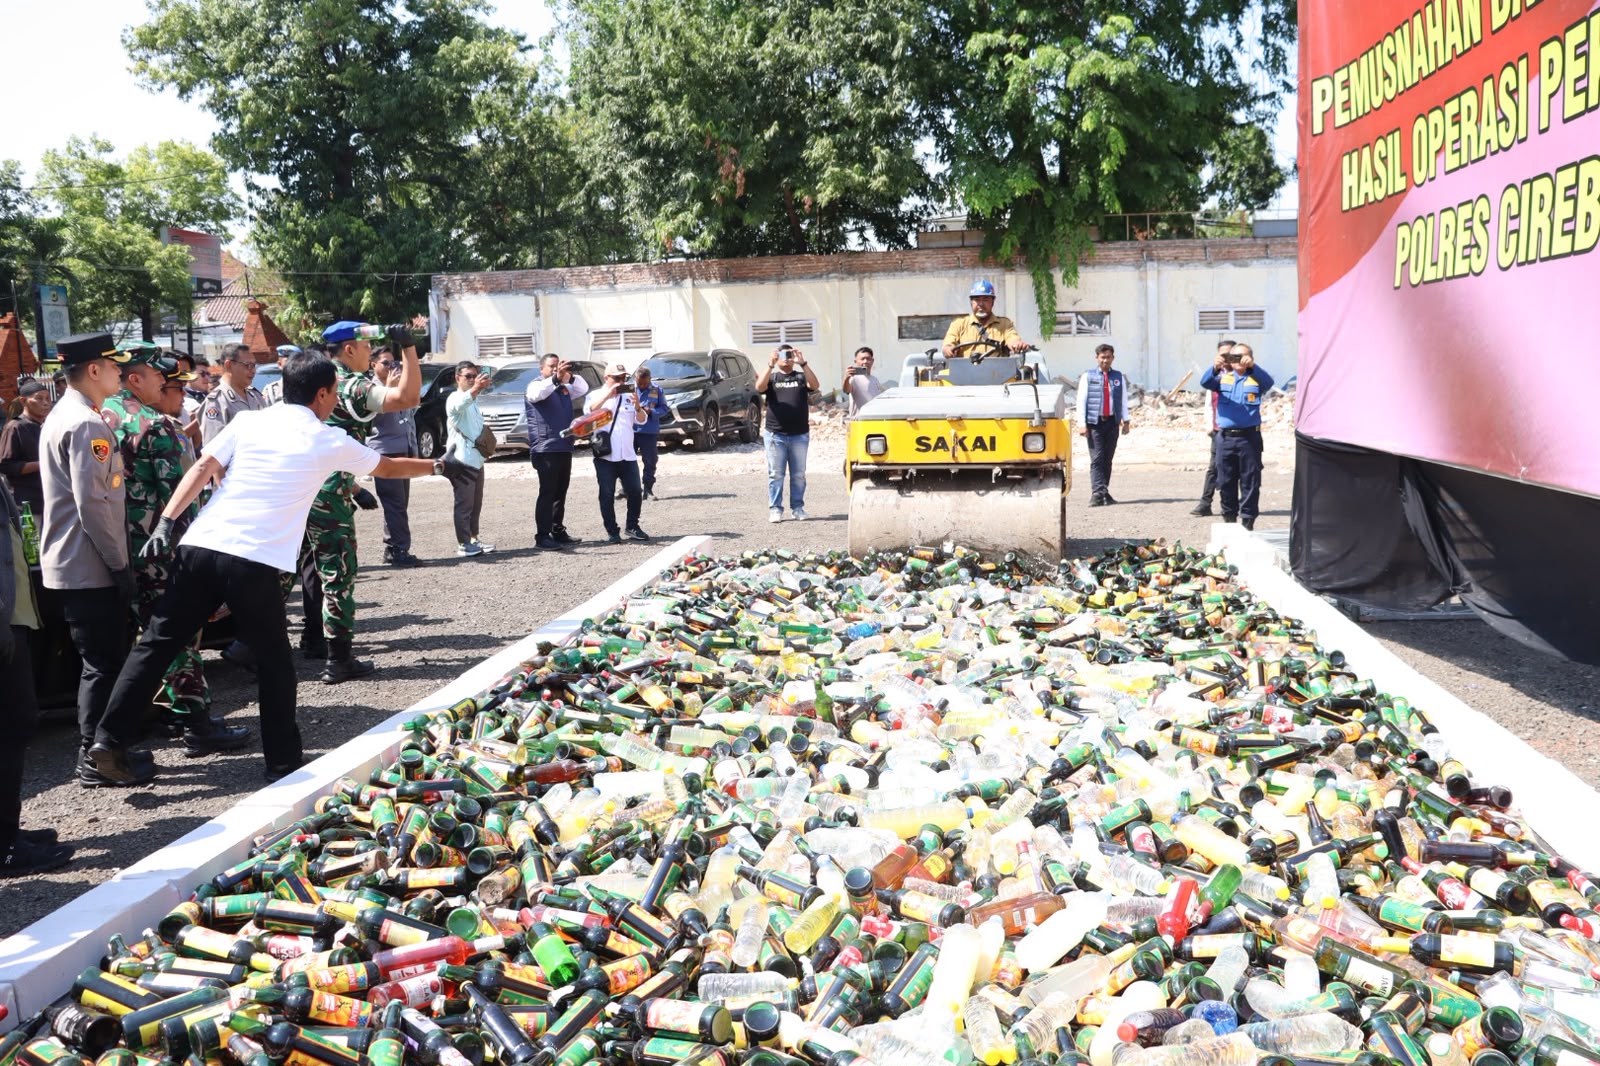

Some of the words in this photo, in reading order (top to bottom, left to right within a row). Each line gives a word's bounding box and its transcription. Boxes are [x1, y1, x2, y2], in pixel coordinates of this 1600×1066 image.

[1312, 0, 1482, 135] PEMUSNAHAN
[1342, 128, 1407, 212] HASIL
[1412, 53, 1529, 187] OPERASI
[1394, 193, 1491, 290] POLRES
[1497, 154, 1600, 271] CIREB
[915, 435, 996, 453] SAKAI
